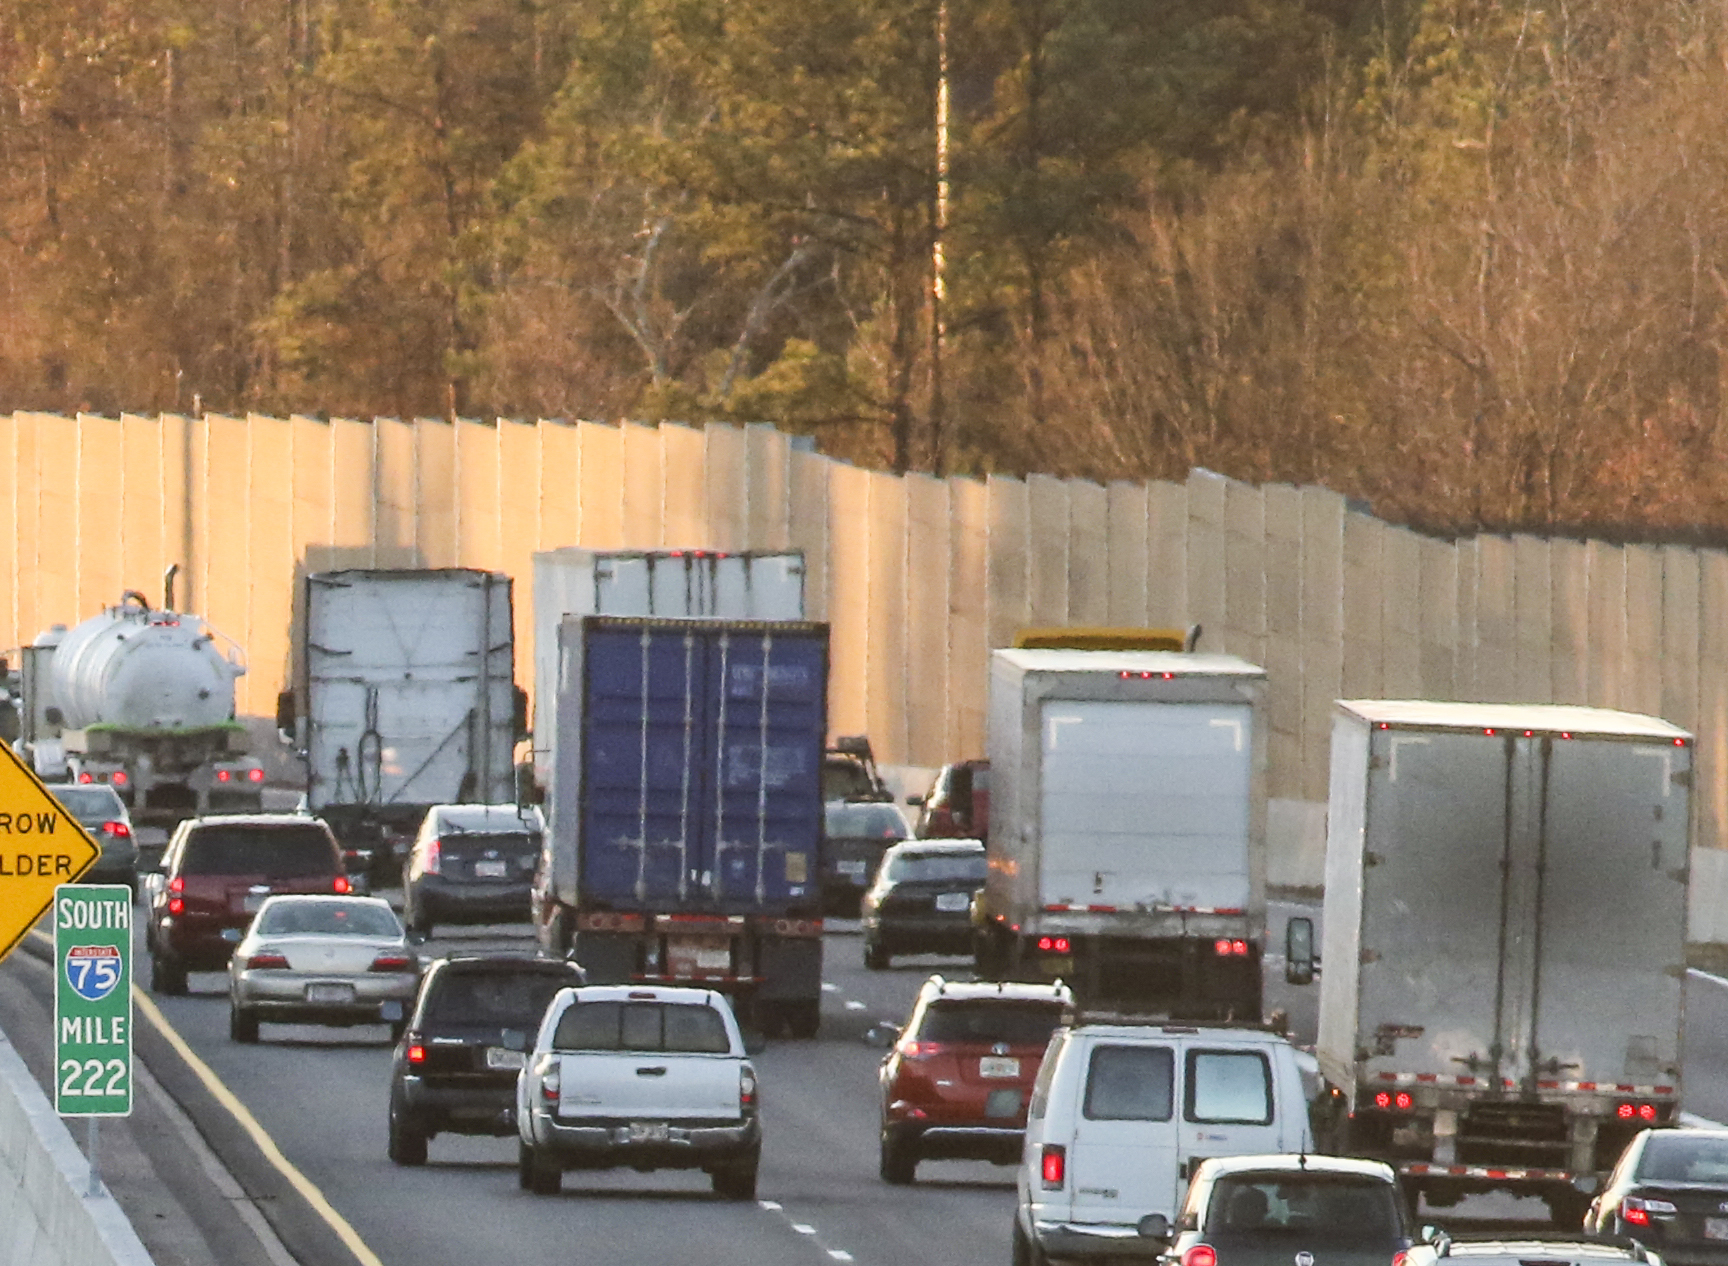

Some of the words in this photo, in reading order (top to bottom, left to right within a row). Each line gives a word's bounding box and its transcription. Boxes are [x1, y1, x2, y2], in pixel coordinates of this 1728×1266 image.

[58, 897, 129, 931] SOUTH
[70, 959, 118, 990] 75
[60, 1016, 126, 1045] MILE
[60, 1059, 127, 1097] 222
